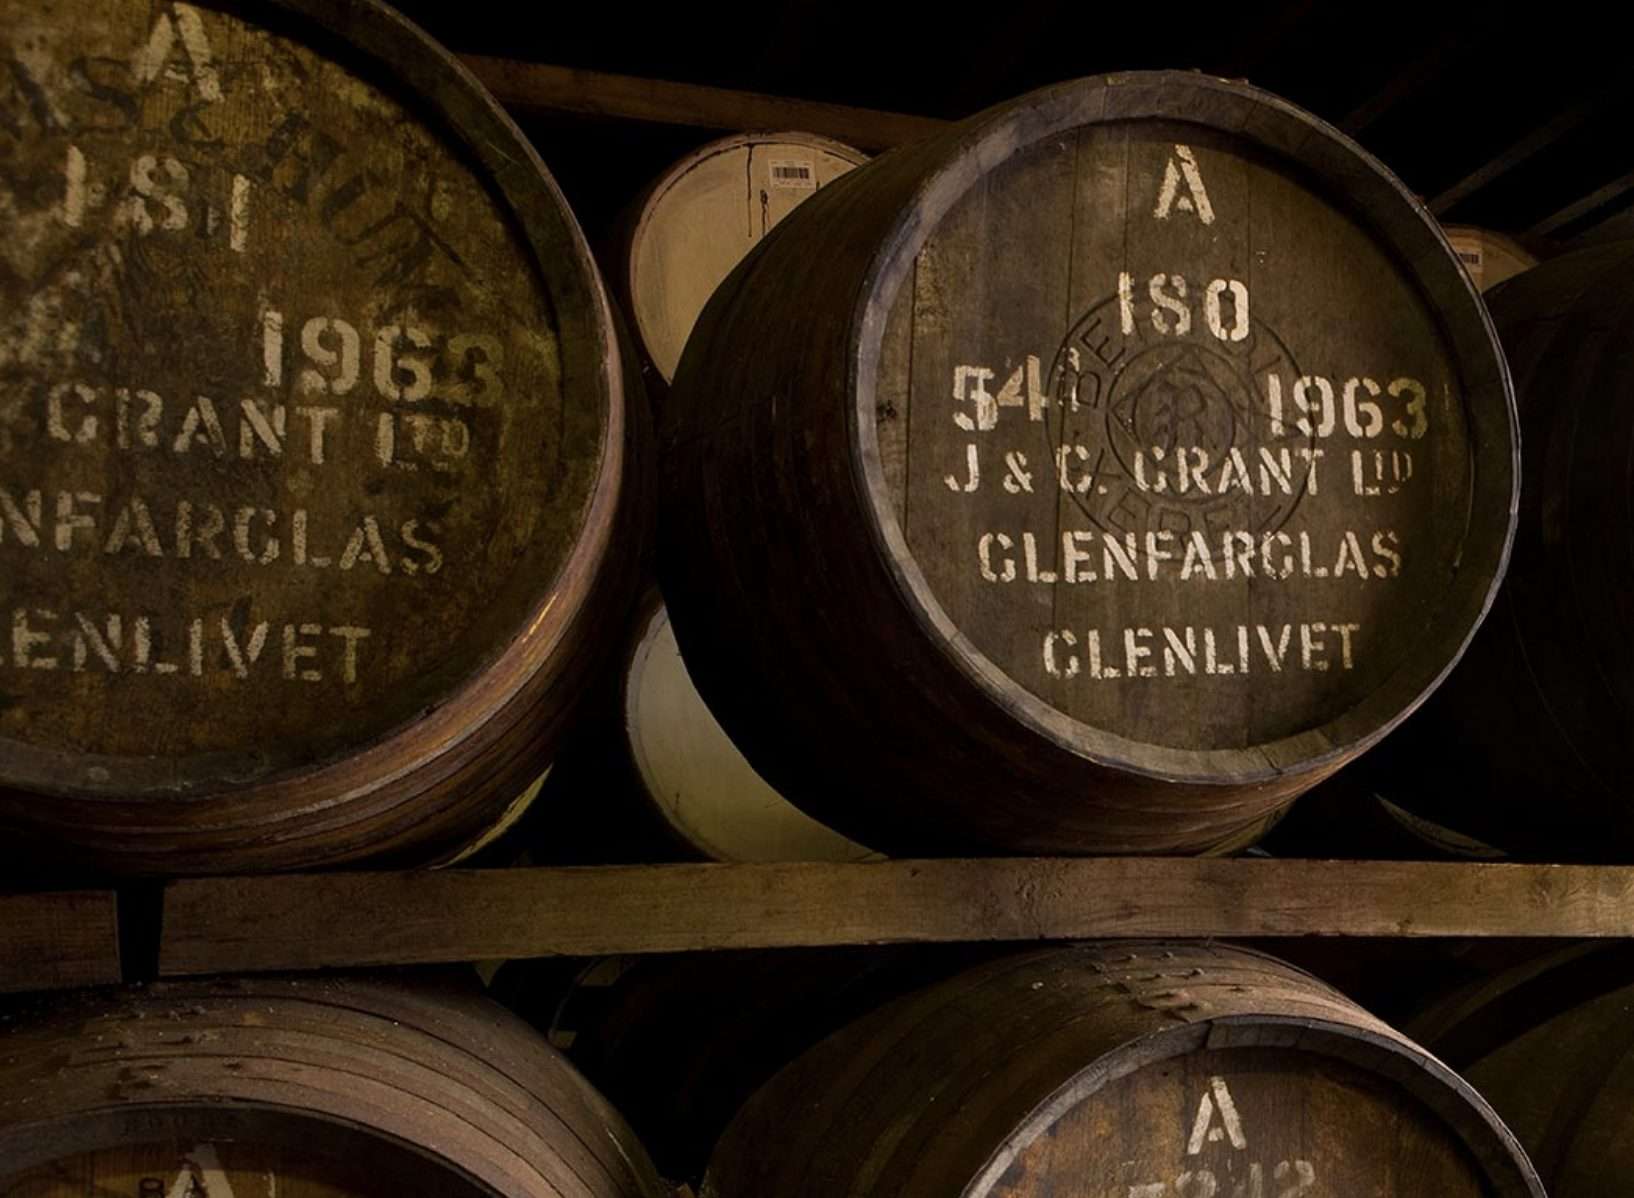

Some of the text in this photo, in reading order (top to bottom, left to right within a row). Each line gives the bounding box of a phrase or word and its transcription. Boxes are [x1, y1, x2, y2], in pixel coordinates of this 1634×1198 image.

[1153, 144, 1216, 225] A
[262, 308, 502, 402] 1963
[48, 384, 338, 463] GRANT
[1267, 373, 1429, 439] 1963
[944, 444, 979, 493] J
[1003, 450, 1034, 494] &
[1134, 446, 1325, 496] GRANT
[978, 530, 1405, 583] GLENFARGLAS
[1042, 622, 1361, 680] GLENLIVET
[1187, 1075, 1247, 1155] A
